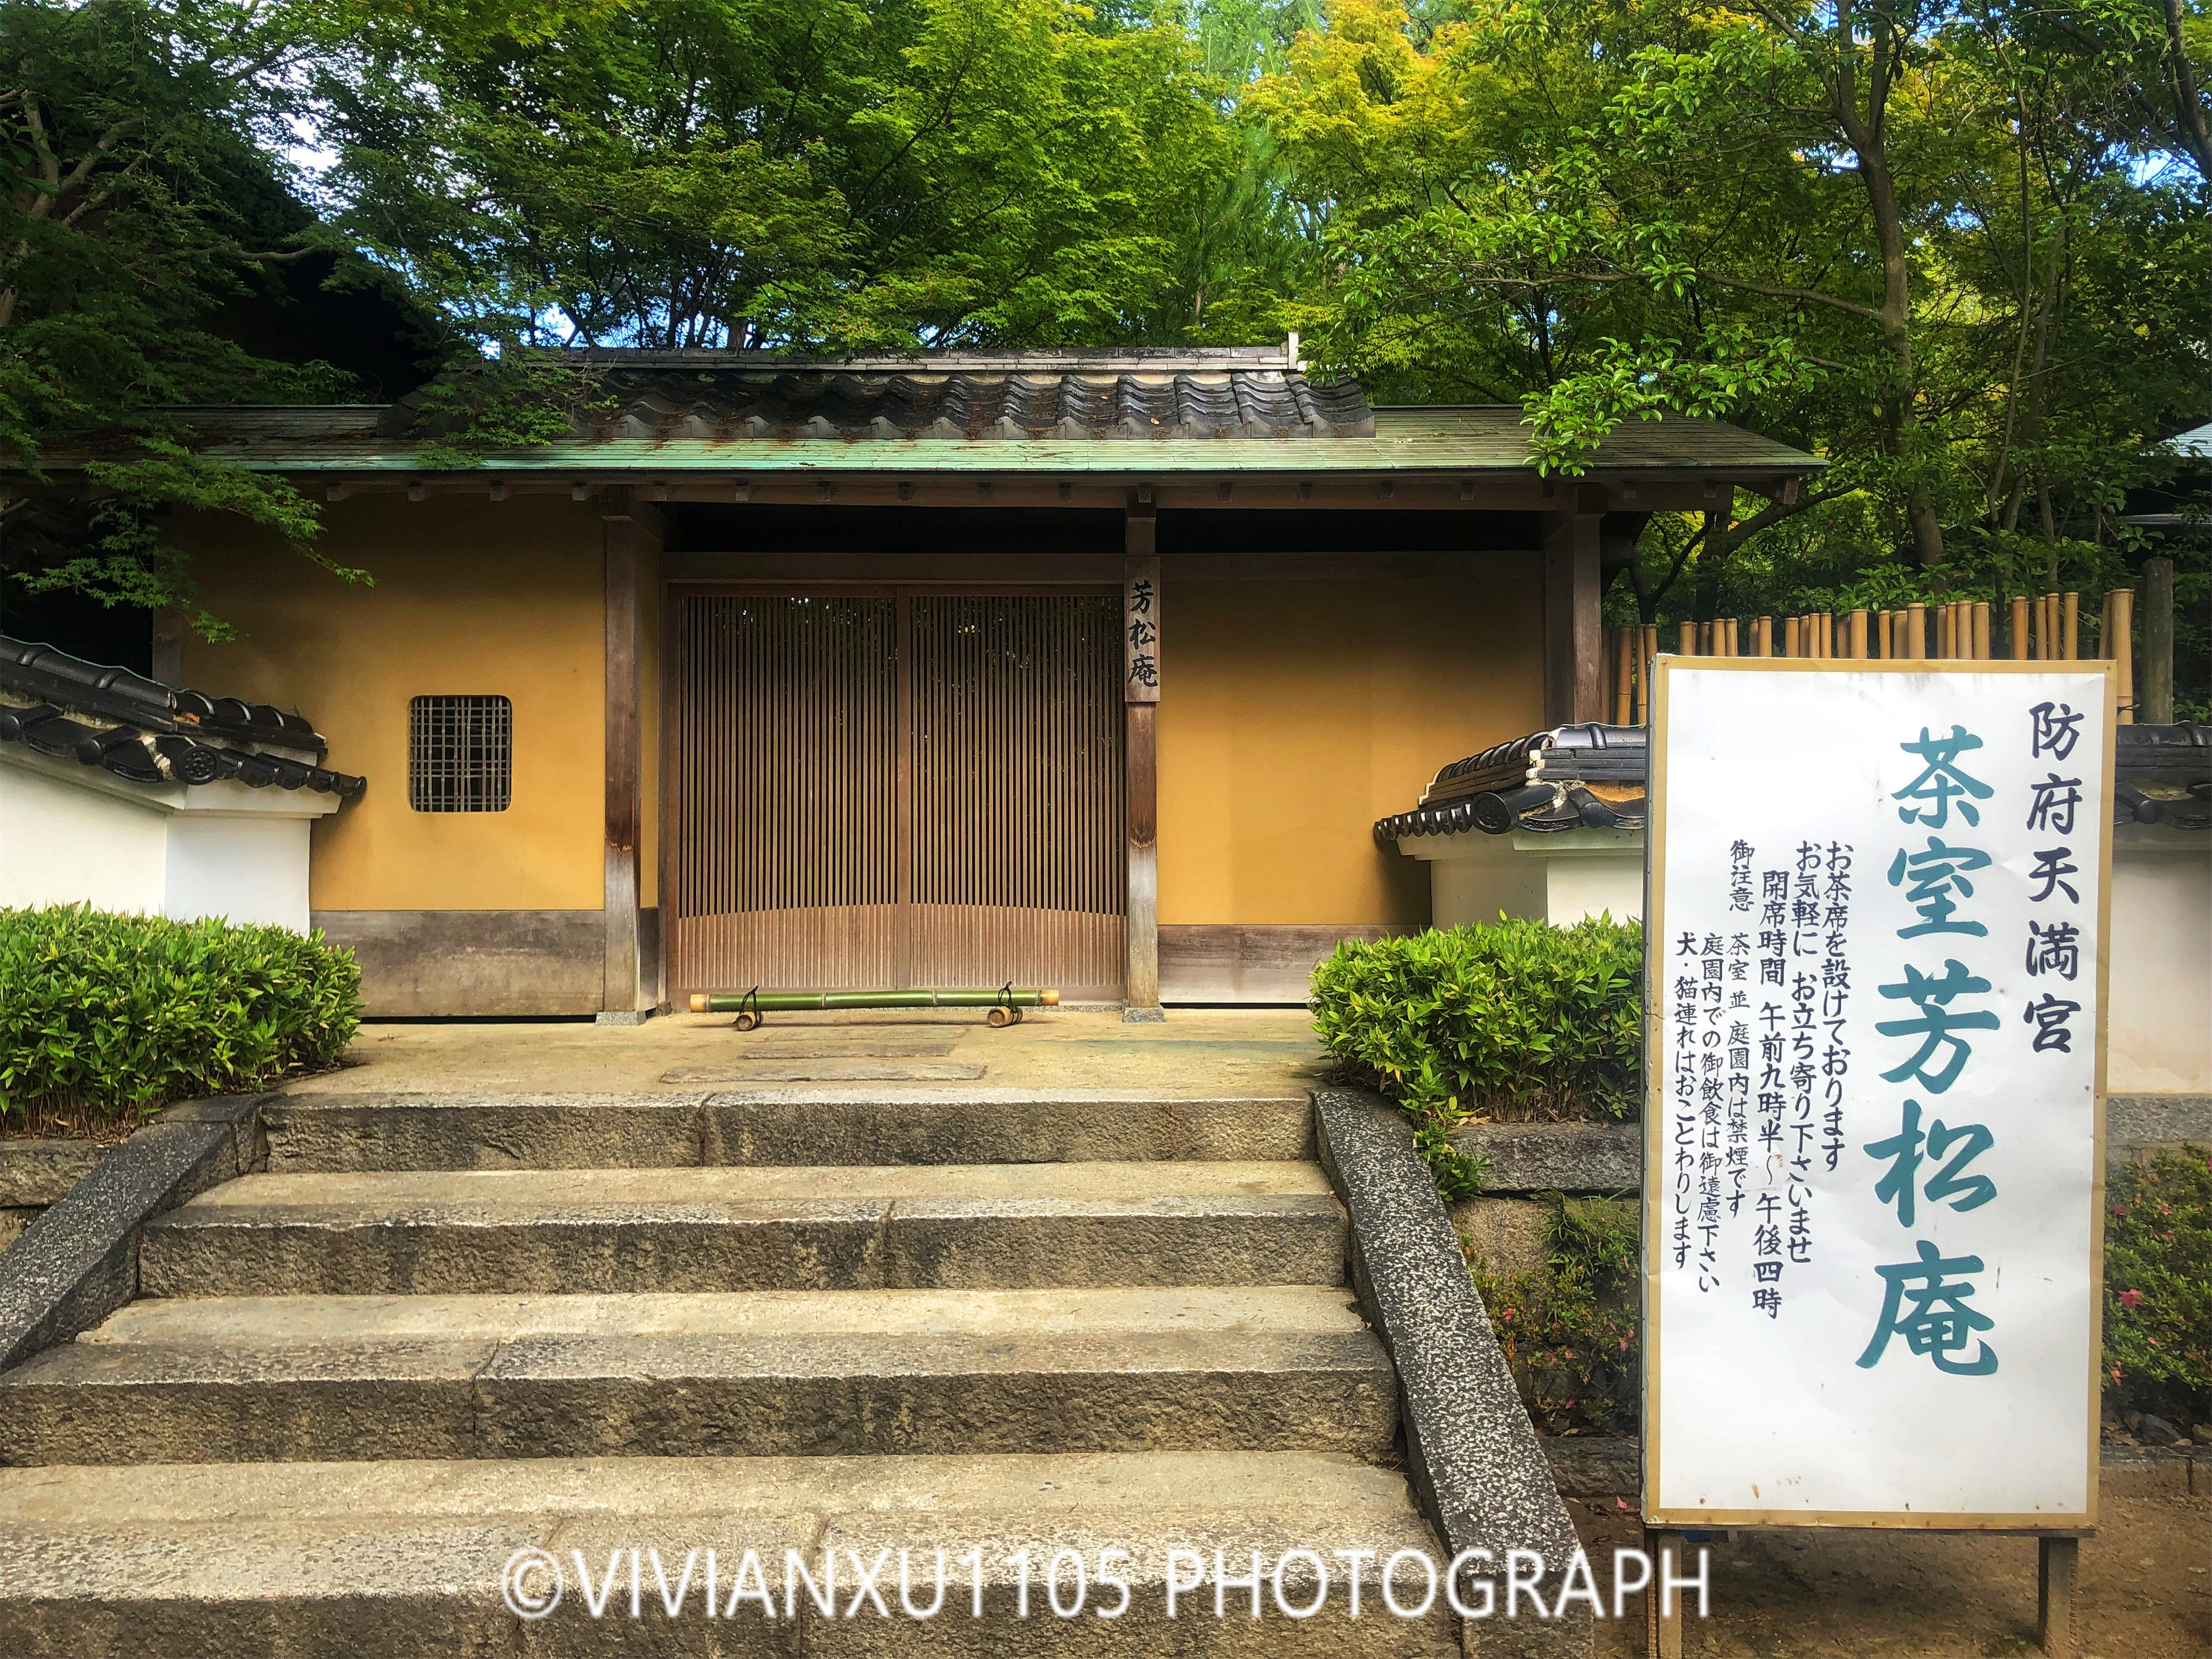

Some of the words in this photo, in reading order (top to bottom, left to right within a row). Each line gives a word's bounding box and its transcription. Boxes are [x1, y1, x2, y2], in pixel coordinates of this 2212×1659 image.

[1128, 579, 1158, 687] 芳松庵
[1821, 841, 1854, 1172] お茶席を設けております
[1855, 725, 2000, 1376] 茶室芳松庵
[2023, 702, 2085, 1053] 防府天満宮
[1697, 932, 1724, 1292] 庭園内での御飲食は御遠慮下さい
